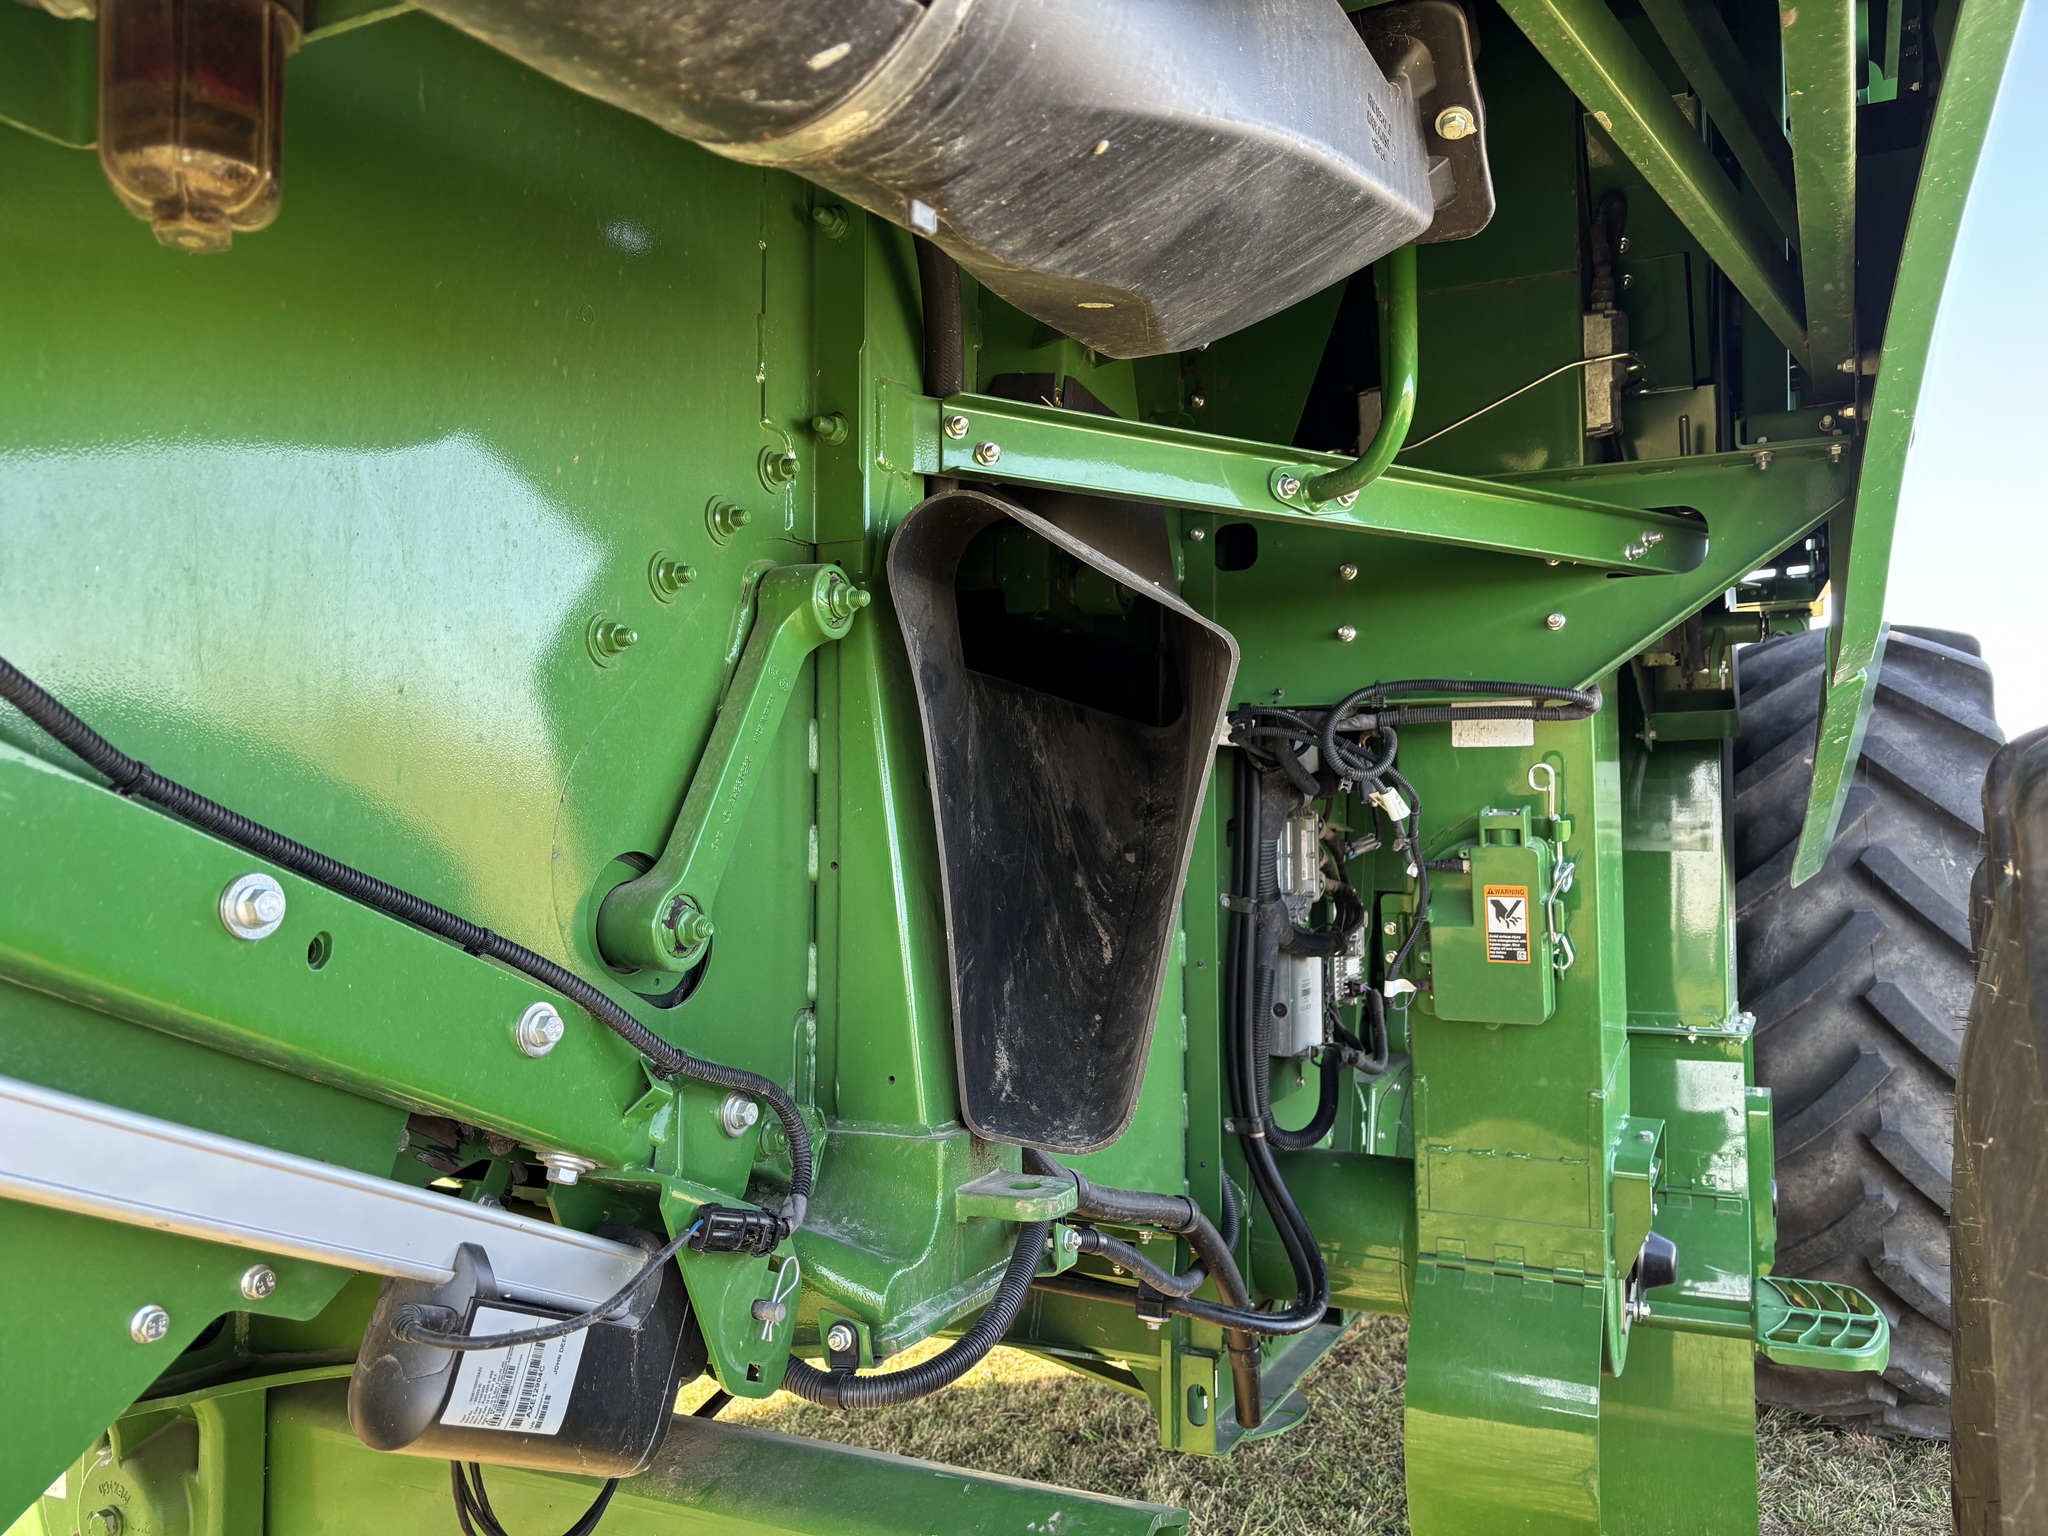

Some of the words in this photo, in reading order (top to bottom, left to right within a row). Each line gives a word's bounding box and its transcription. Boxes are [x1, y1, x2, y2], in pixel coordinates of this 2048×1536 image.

[1494, 888, 1525, 896] WARNING
[553, 1354, 562, 1375] JOHN
[526, 1365, 545, 1419] AXE12904C
